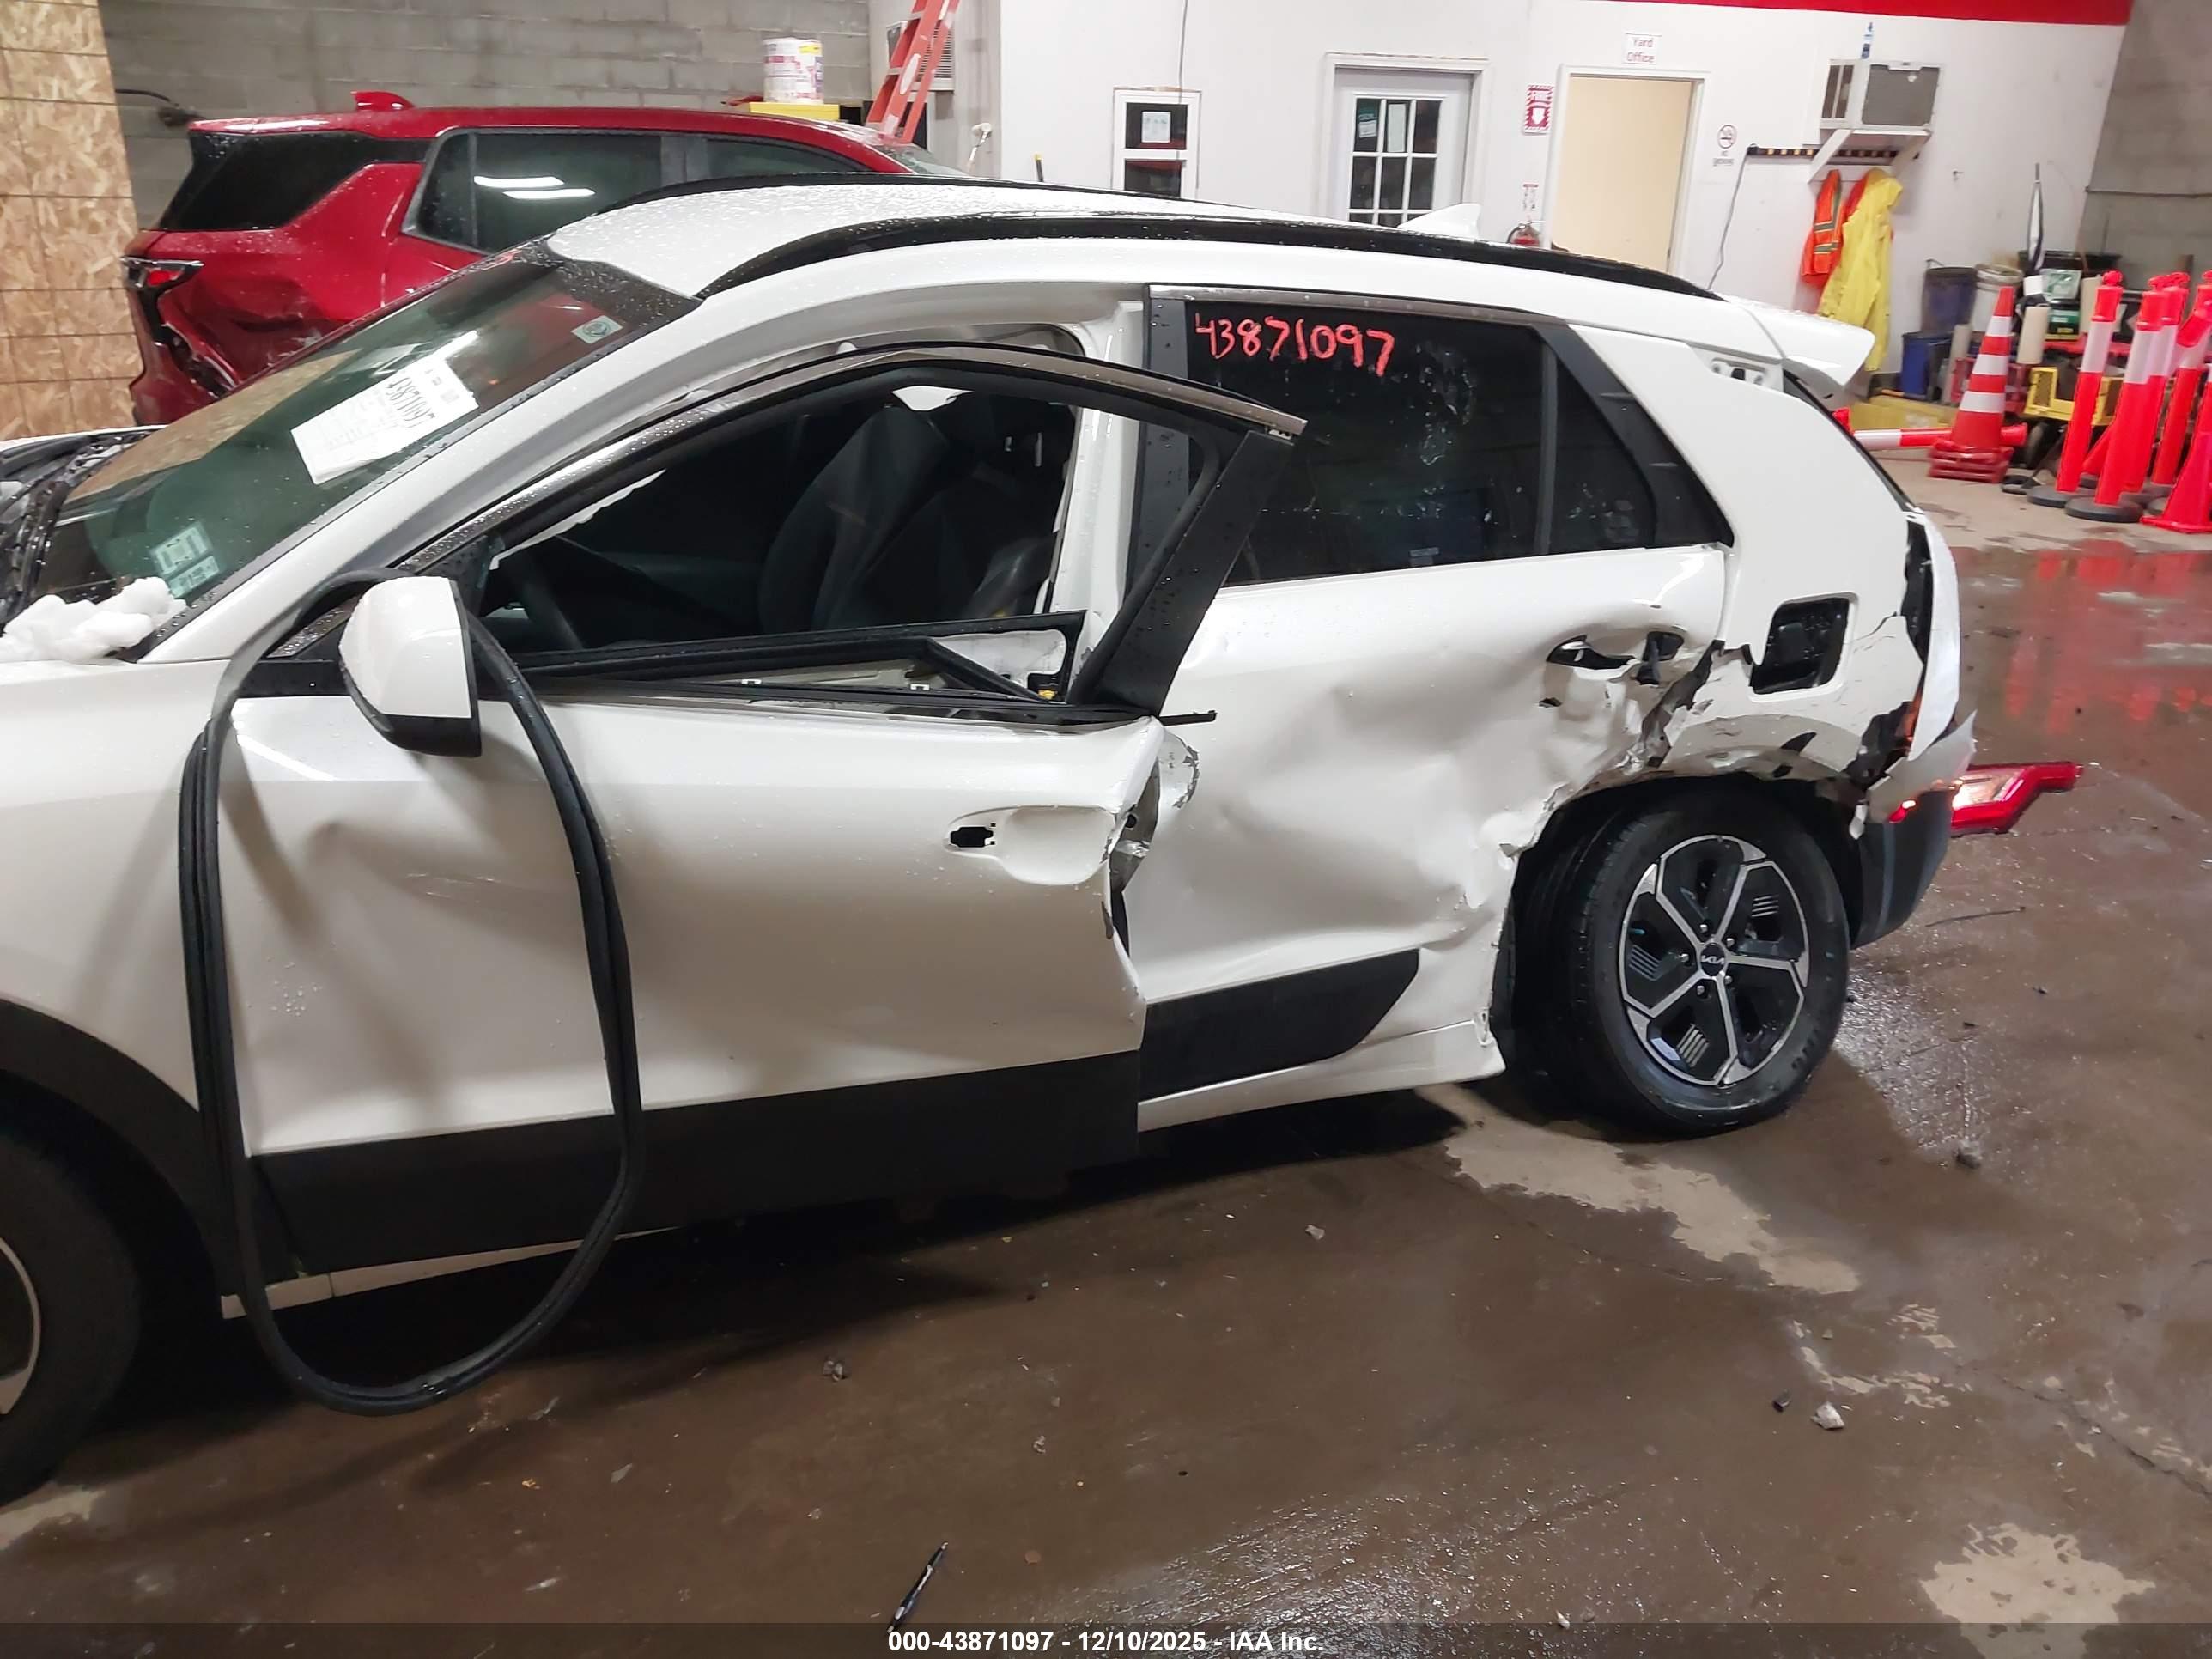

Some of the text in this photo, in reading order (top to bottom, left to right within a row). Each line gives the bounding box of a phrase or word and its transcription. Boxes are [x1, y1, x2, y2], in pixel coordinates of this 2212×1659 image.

[1633, 38, 1654, 48] Yard
[1626, 51, 1656, 63] Office
[1195, 312, 1395, 377] 43871097
